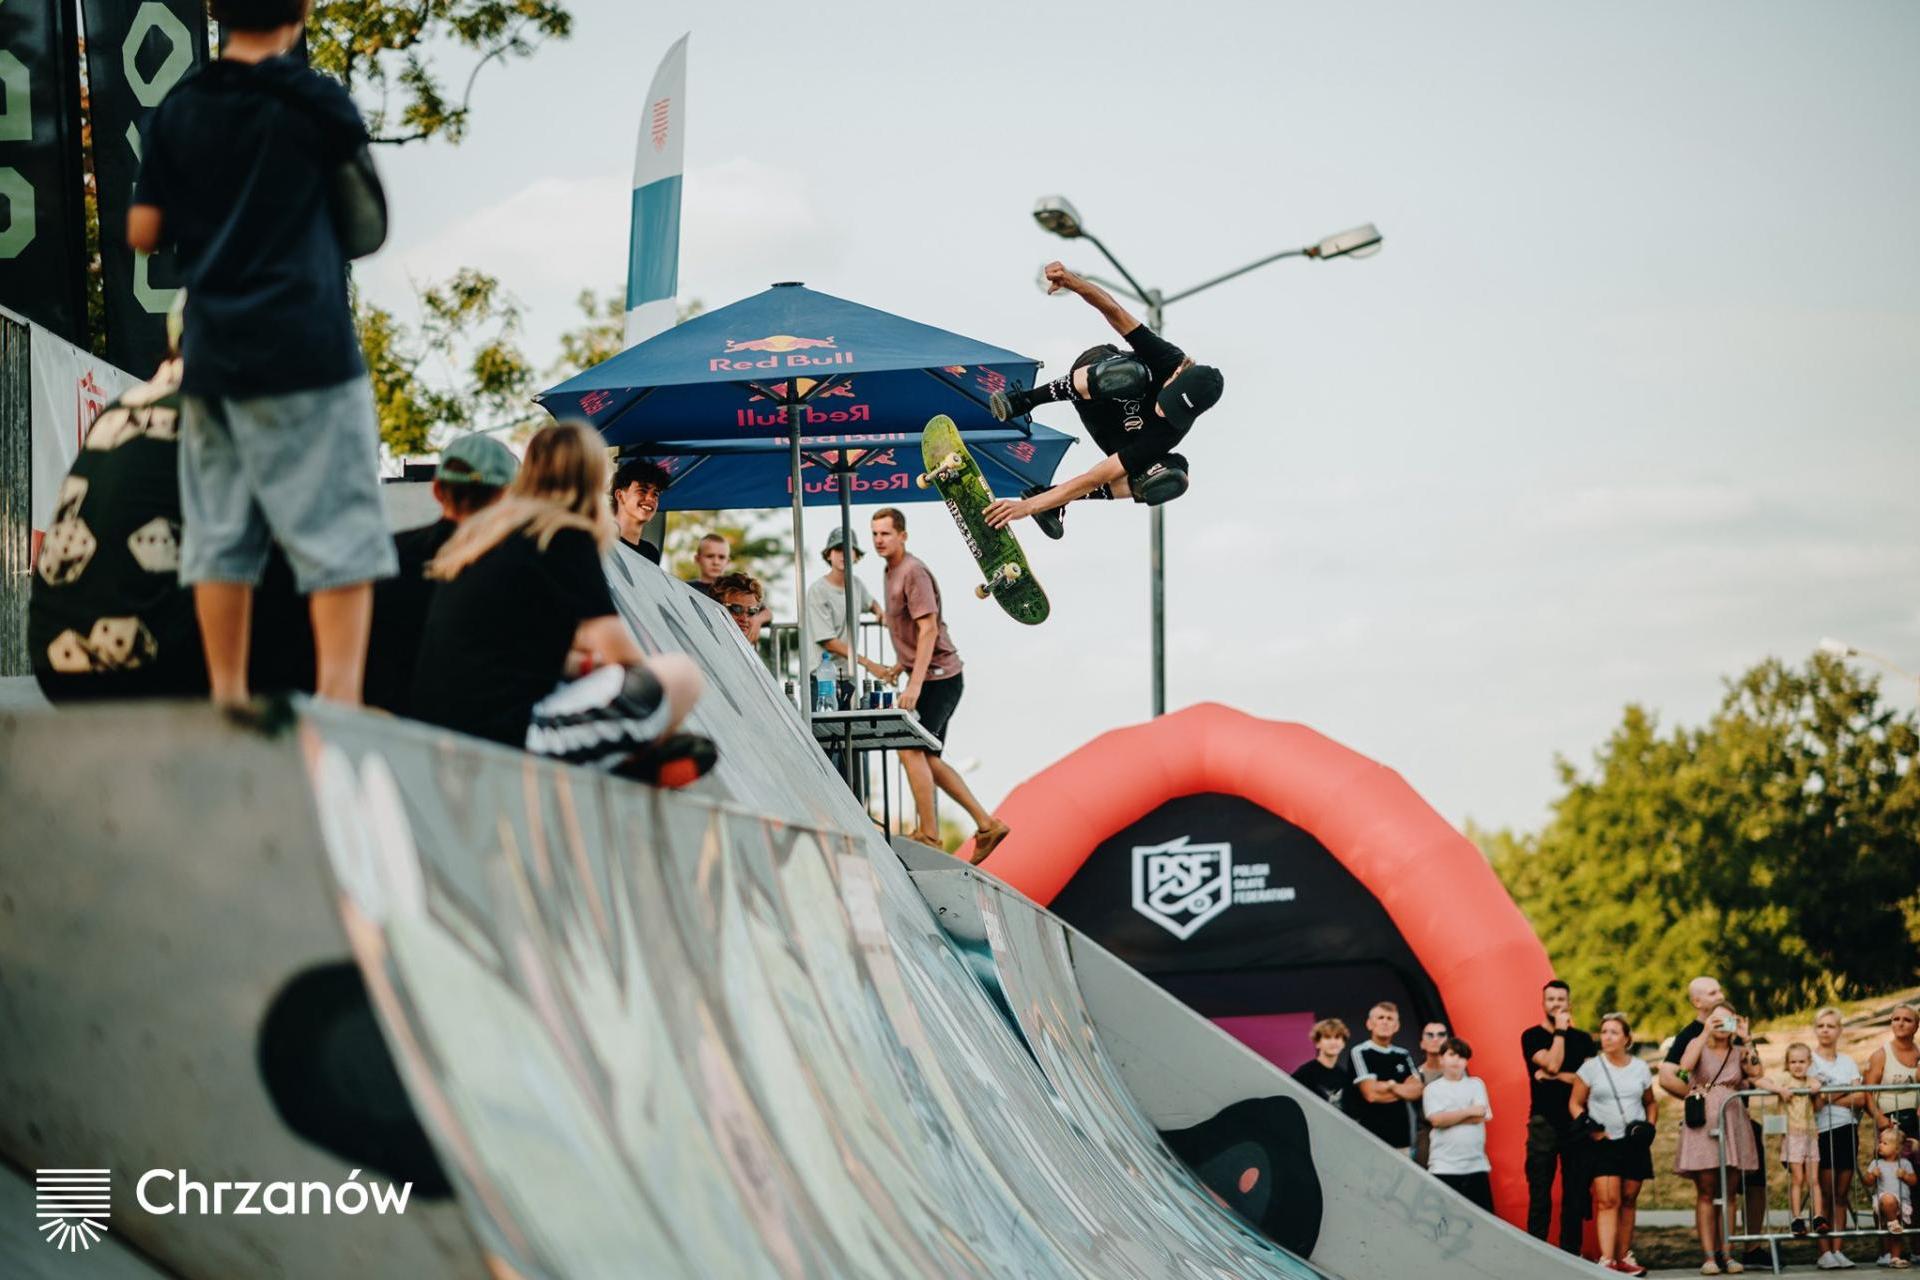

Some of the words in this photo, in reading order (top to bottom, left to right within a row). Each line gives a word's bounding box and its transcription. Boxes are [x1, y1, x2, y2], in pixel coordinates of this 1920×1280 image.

[709, 355, 778, 371] Red
[787, 351, 854, 367] Bull
[1148, 853, 1213, 896] PSF
